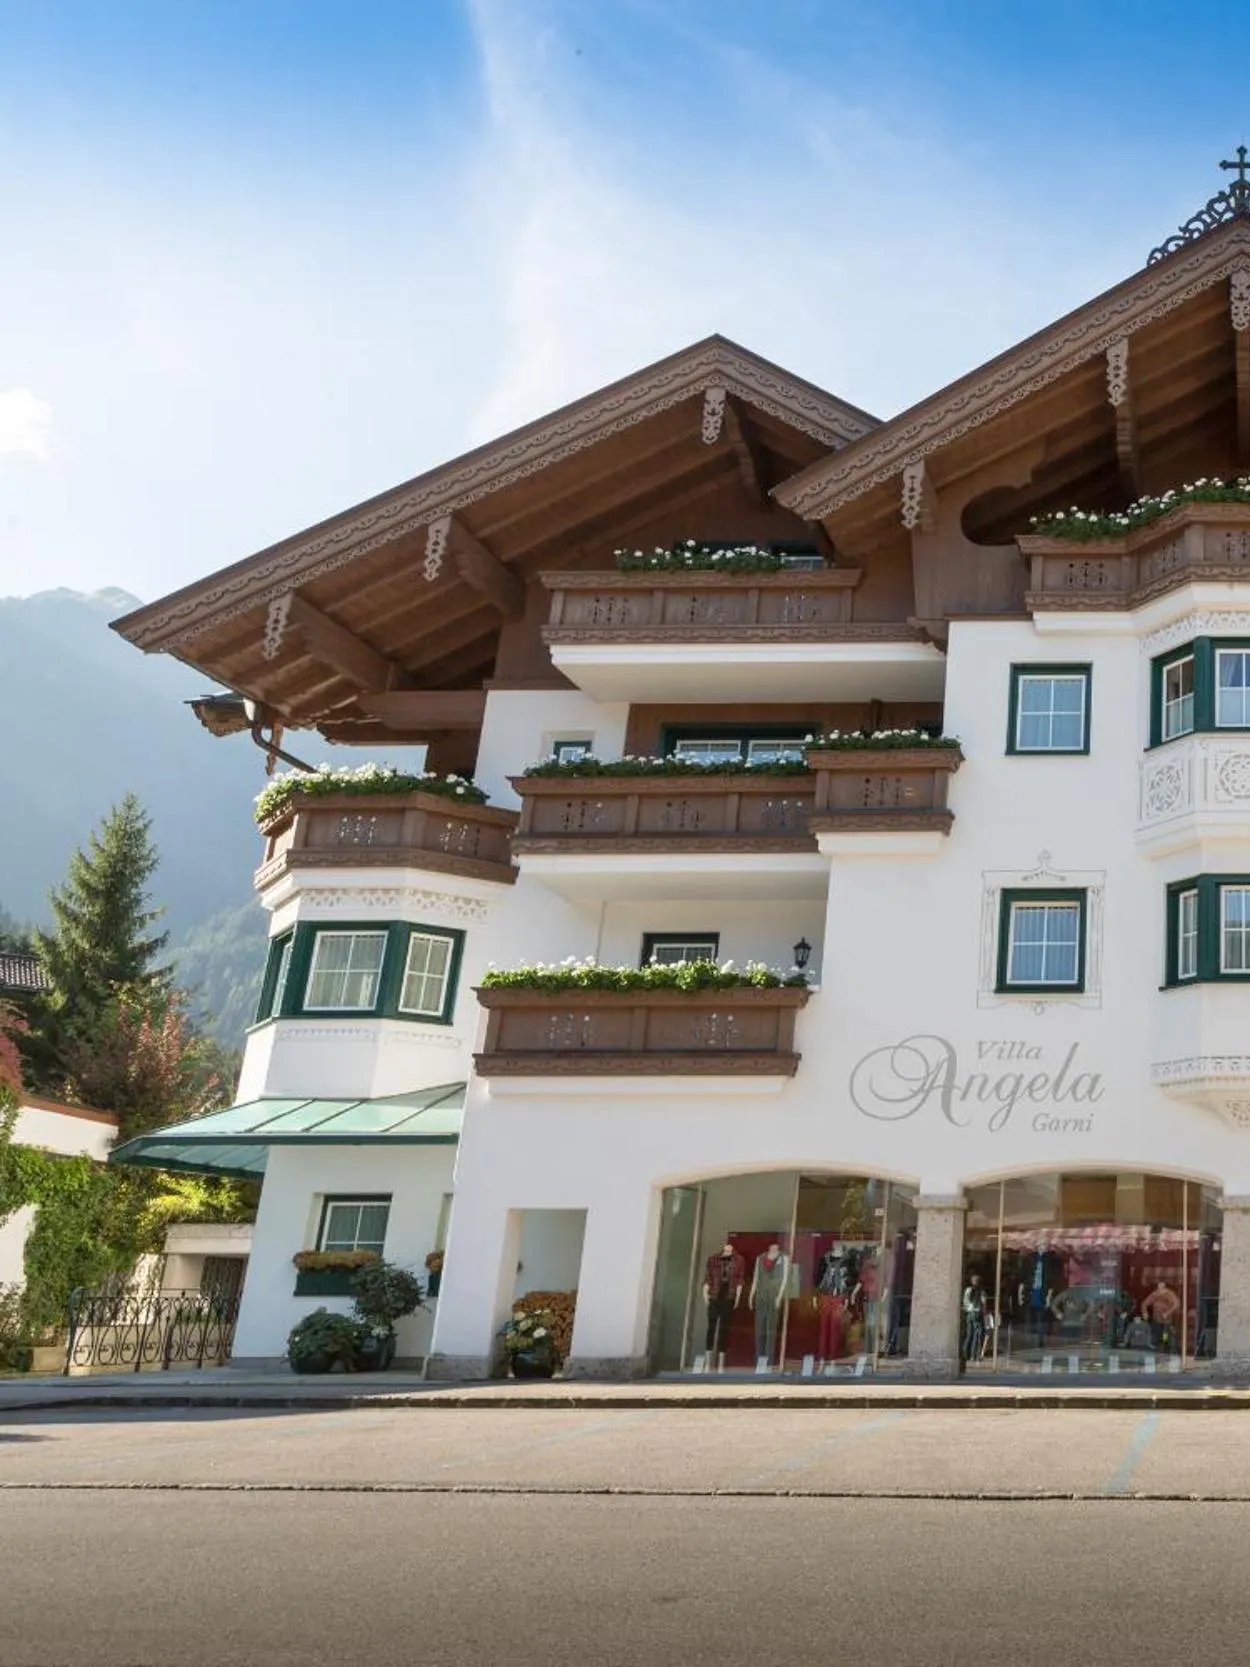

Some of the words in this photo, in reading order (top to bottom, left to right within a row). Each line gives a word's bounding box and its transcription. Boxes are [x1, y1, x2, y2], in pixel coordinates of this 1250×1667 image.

[976, 1040, 1043, 1060] Villa
[850, 1034, 1106, 1132] Angela
[1031, 1112, 1094, 1132] Garni
